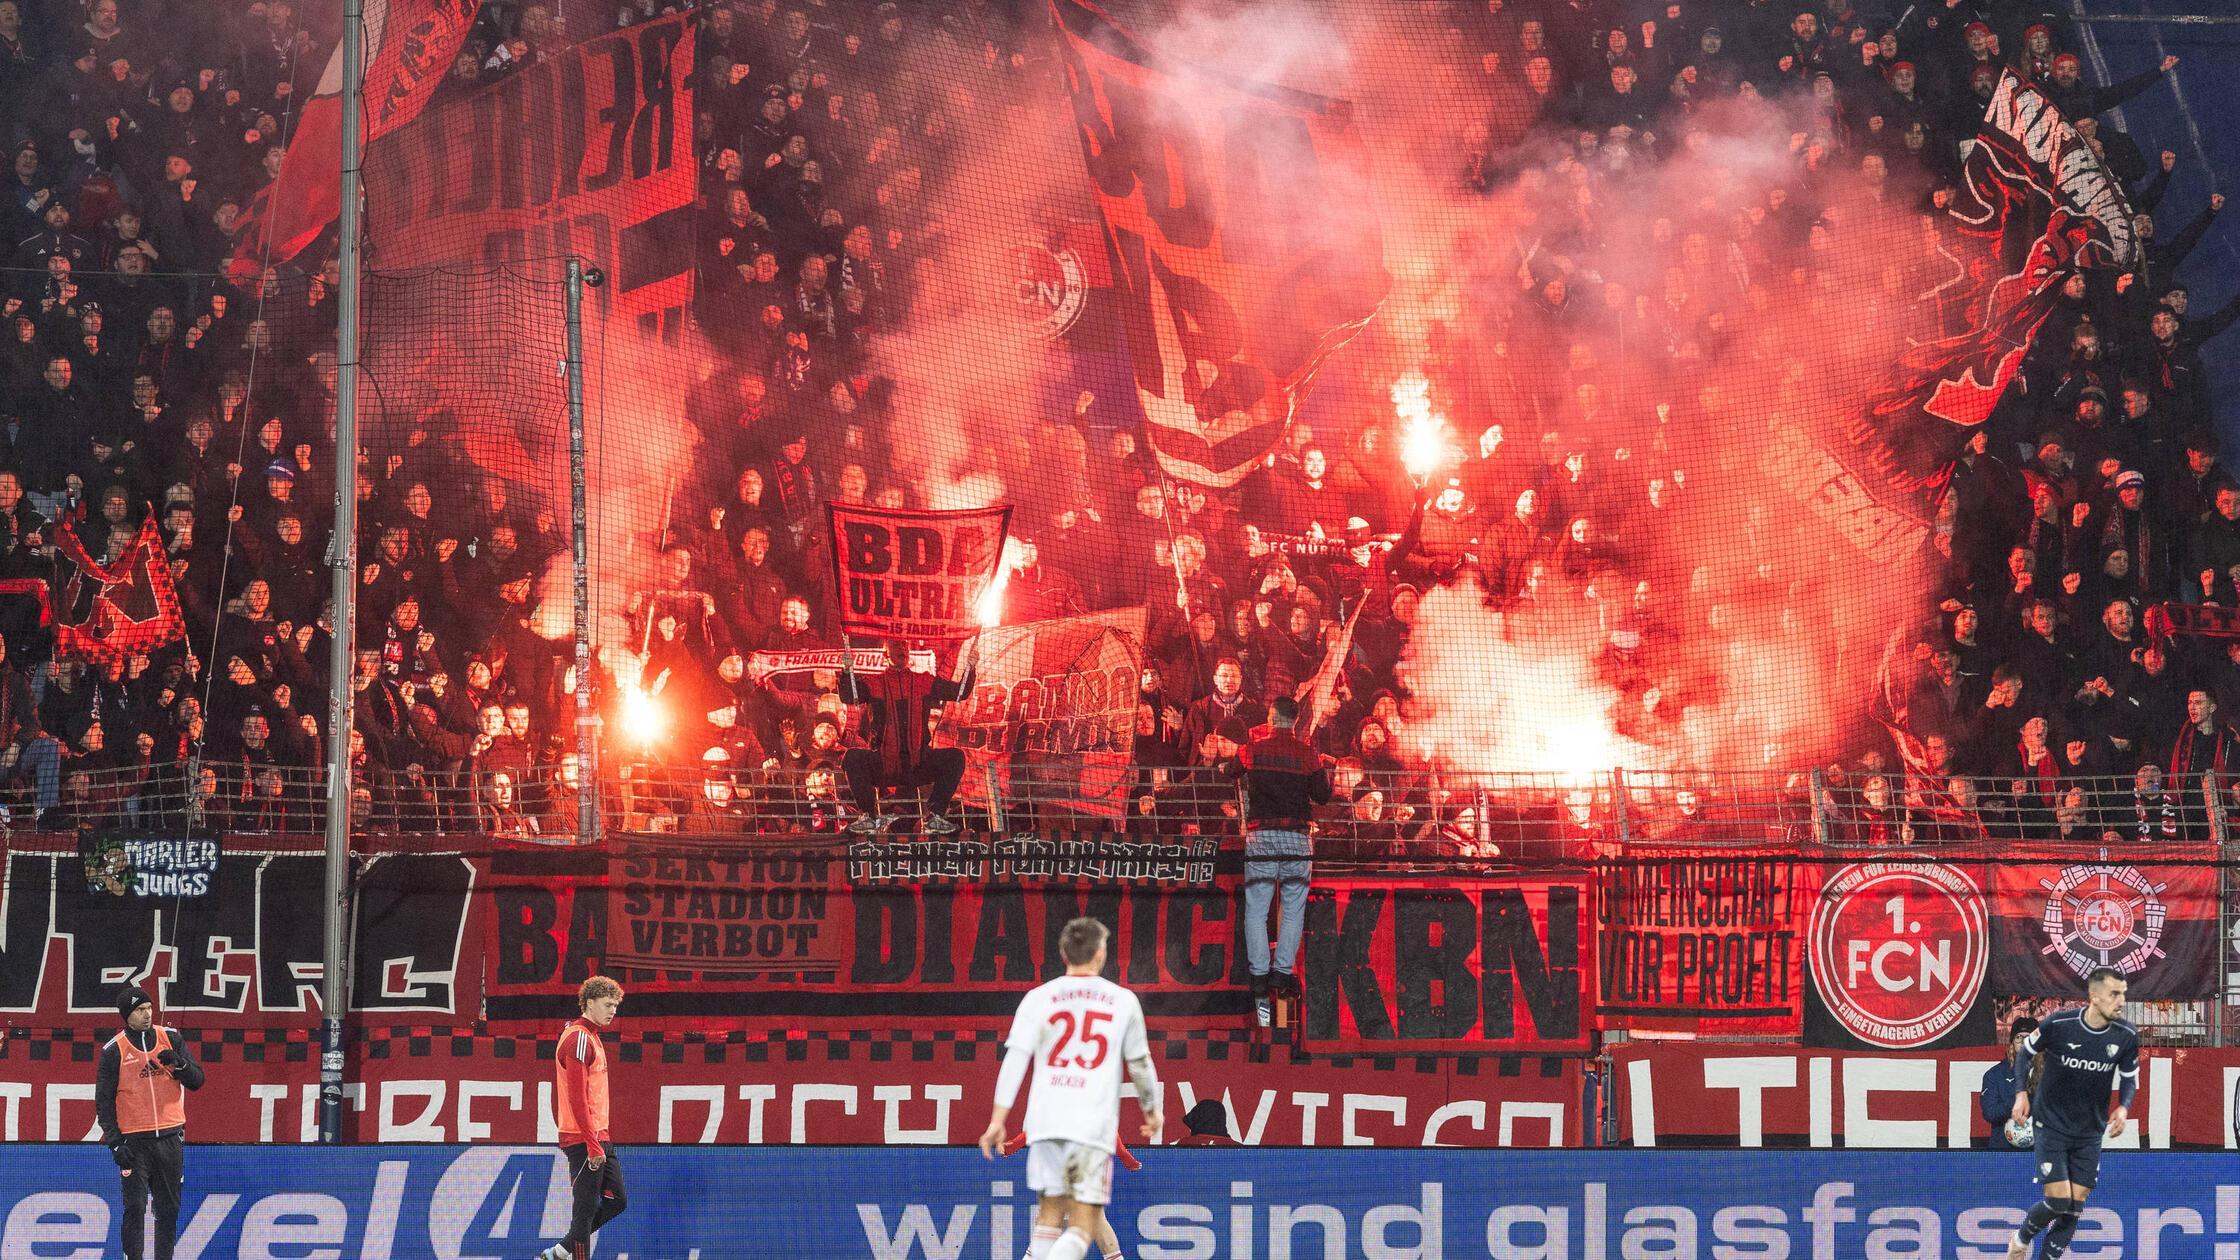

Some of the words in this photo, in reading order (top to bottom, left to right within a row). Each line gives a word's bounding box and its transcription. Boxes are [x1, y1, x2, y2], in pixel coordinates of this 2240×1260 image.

[124, 841, 217, 870] MARLER
[624, 847, 829, 884] SEKTION
[133, 872, 208, 897] JUNGS
[624, 883, 828, 921] STADION
[1598, 856, 1794, 927] GEMEINSCHAFT
[1886, 893, 1921, 934] 1.
[2087, 915, 2121, 932] FCN
[630, 920, 818, 957] VERBOT
[1304, 885, 1580, 1040] KBN
[1600, 931, 1663, 1003] VOR
[1677, 931, 1795, 1004] PROFIT
[1848, 939, 1951, 993] FCN
[1047, 1010, 1113, 1070] 25
[1838, 1002, 1926, 1041] EINGETRAGENER
[1923, 1001, 1963, 1034] VEREIN
[1136, 1181, 1444, 1260] sind
